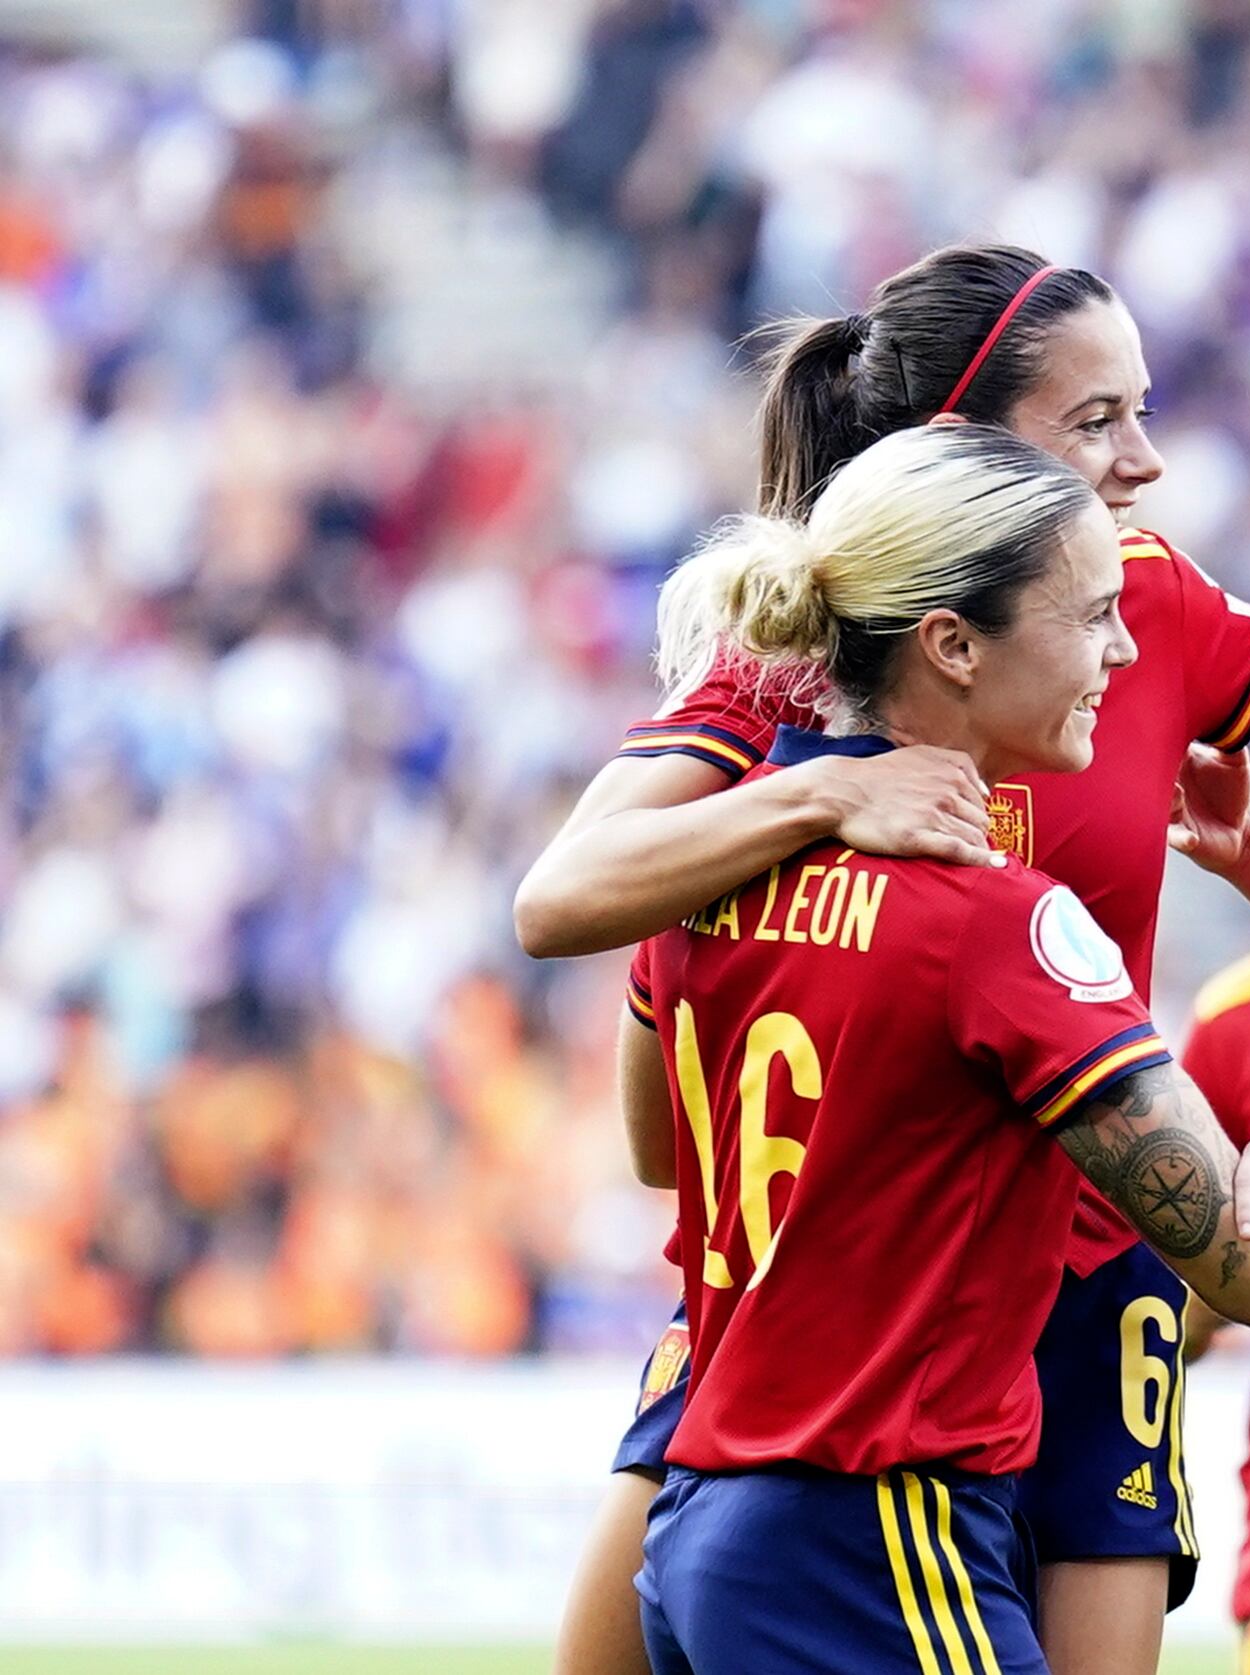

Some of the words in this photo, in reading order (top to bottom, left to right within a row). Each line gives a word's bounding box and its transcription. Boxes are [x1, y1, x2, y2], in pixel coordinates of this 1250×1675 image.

[753, 849, 889, 953] LEÓN
[674, 997, 823, 1292] 16
[1120, 1295, 1178, 1449] 6
[1116, 1486, 1158, 1510] adidas
